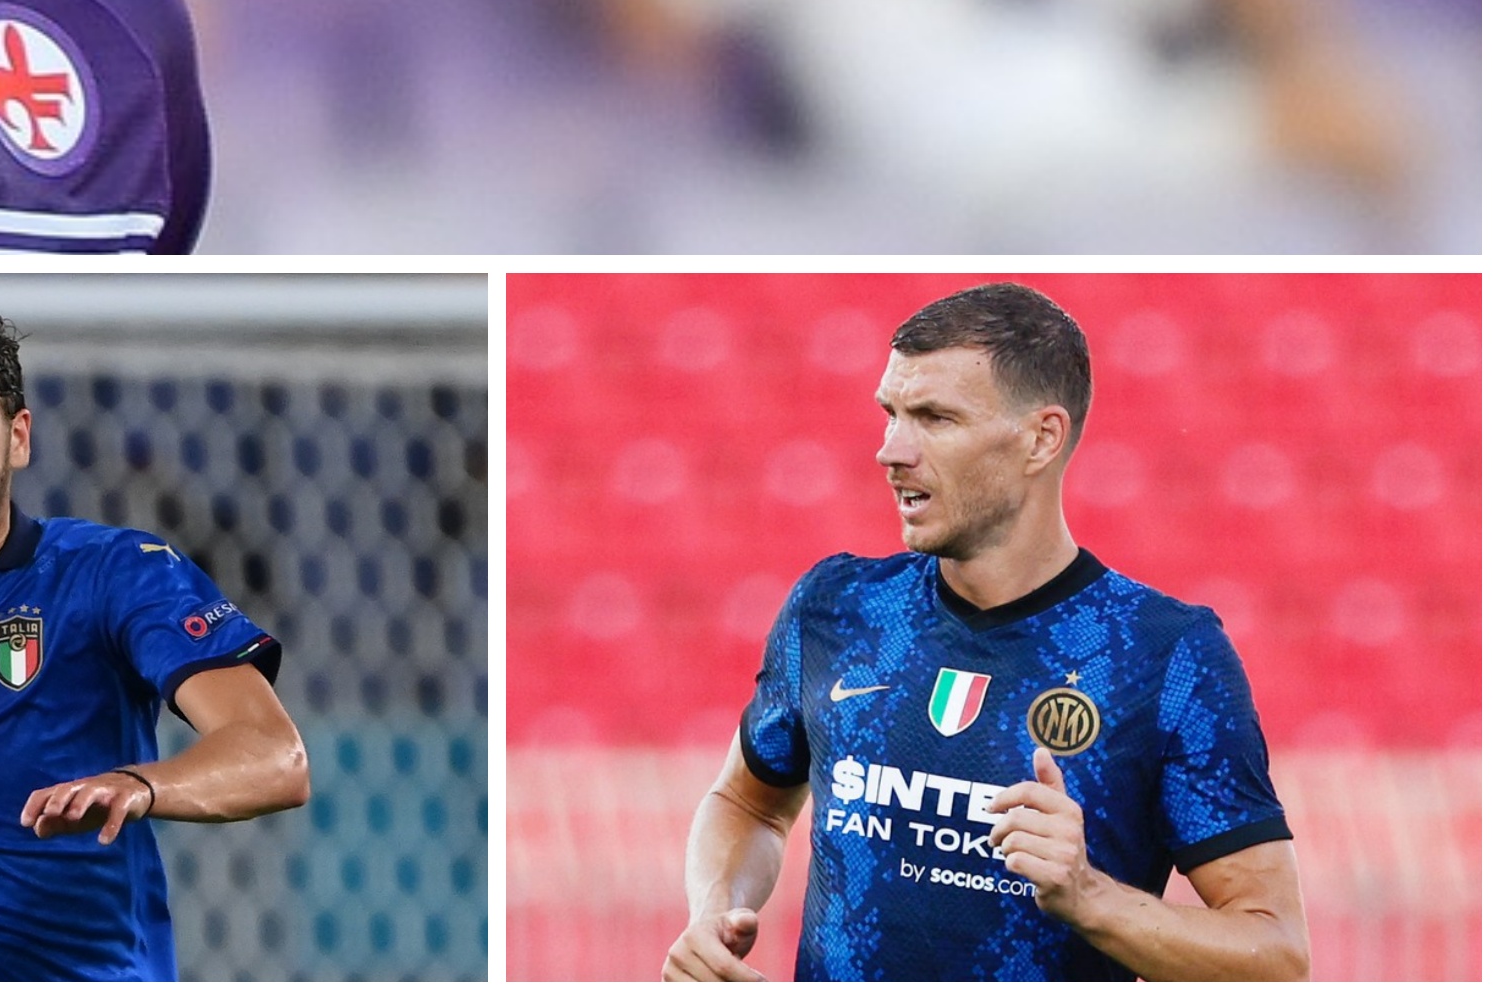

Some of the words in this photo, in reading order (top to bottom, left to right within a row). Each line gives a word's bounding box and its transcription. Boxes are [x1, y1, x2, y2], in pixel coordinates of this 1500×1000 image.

[831, 755, 1024, 825] $INTE
[825, 808, 892, 841] FAN
[908, 821, 1008, 861] TOK
[900, 857, 926, 883] by
